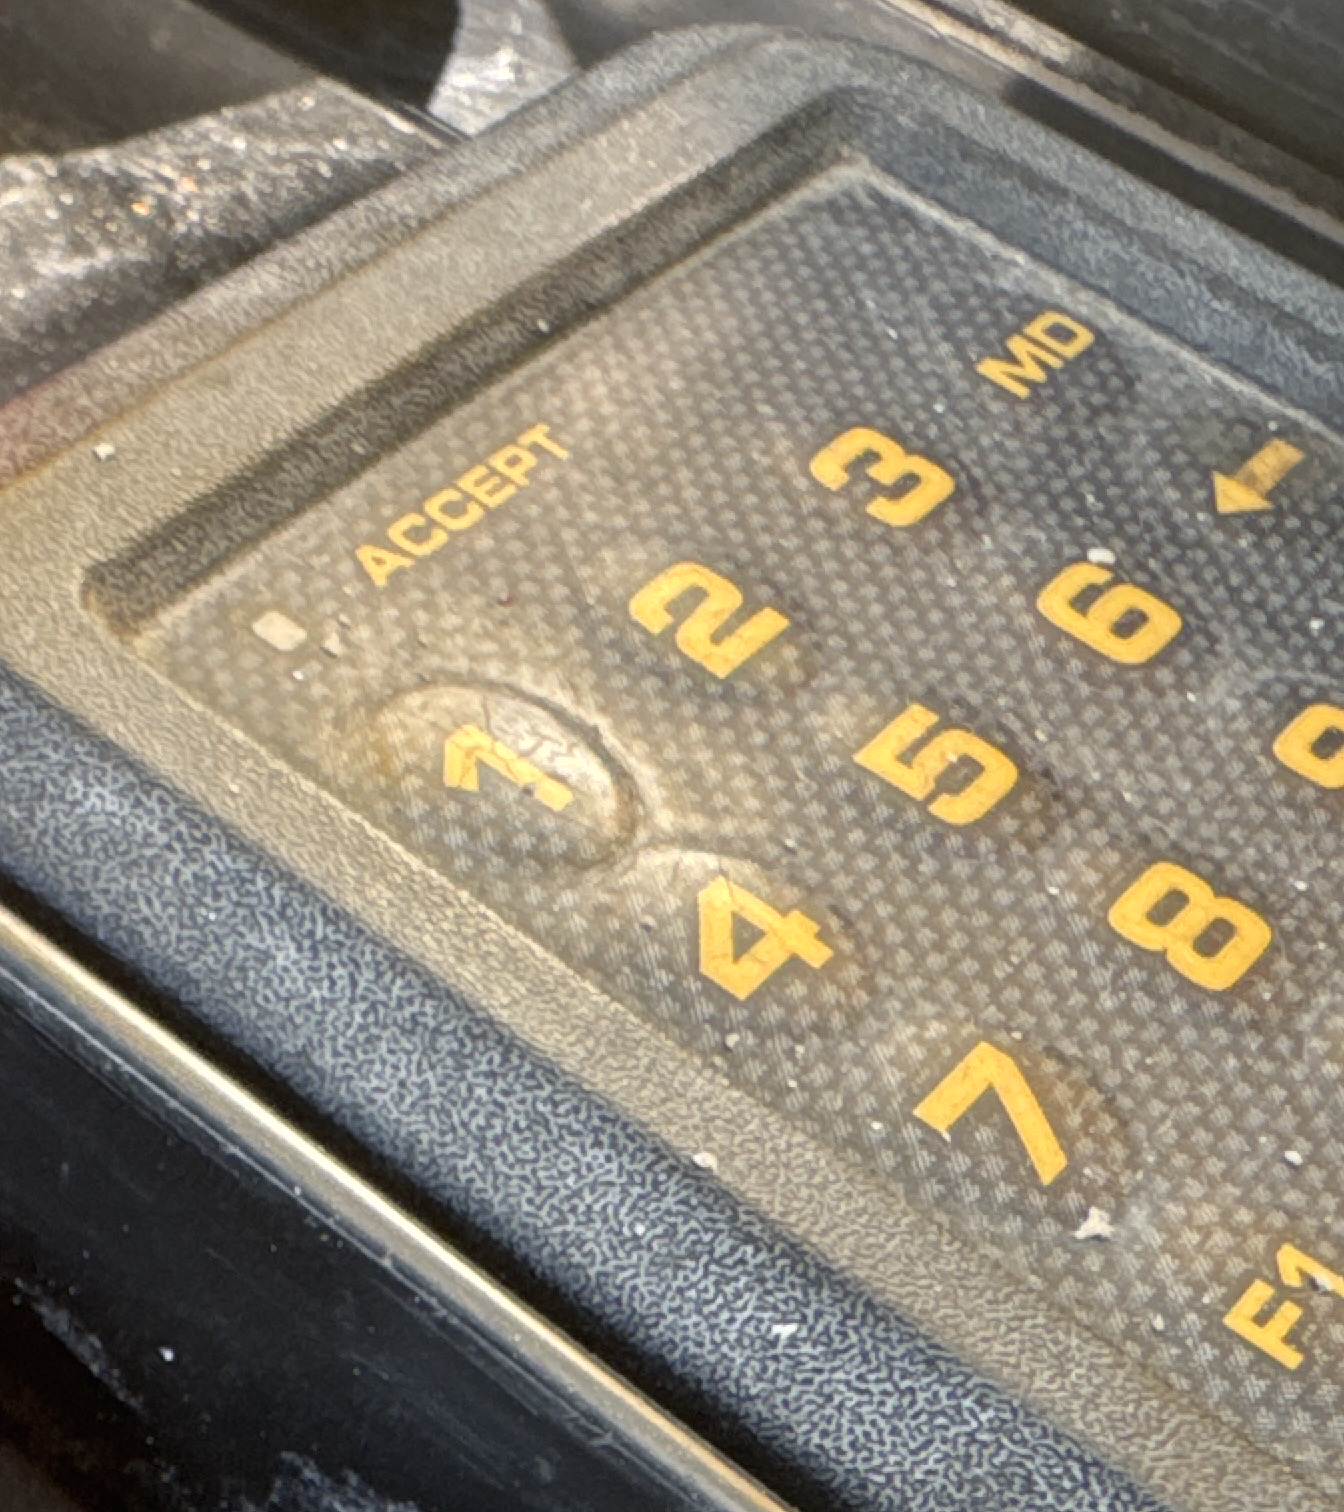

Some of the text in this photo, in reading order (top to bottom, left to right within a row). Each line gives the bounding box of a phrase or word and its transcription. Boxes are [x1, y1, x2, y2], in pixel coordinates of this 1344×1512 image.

[975, 309, 1096, 400] MD
[354, 421, 573, 588] ACCEPT
[808, 426, 956, 527] 3
[627, 560, 791, 680] 2
[1036, 561, 1184, 665] 6
[442, 723, 573, 812] 1
[853, 703, 1019, 826] 5
[698, 874, 835, 1001] 4
[1107, 861, 1273, 992] 8
[912, 1040, 1069, 1186] 7
[1222, 1242, 1344, 1370] F1
